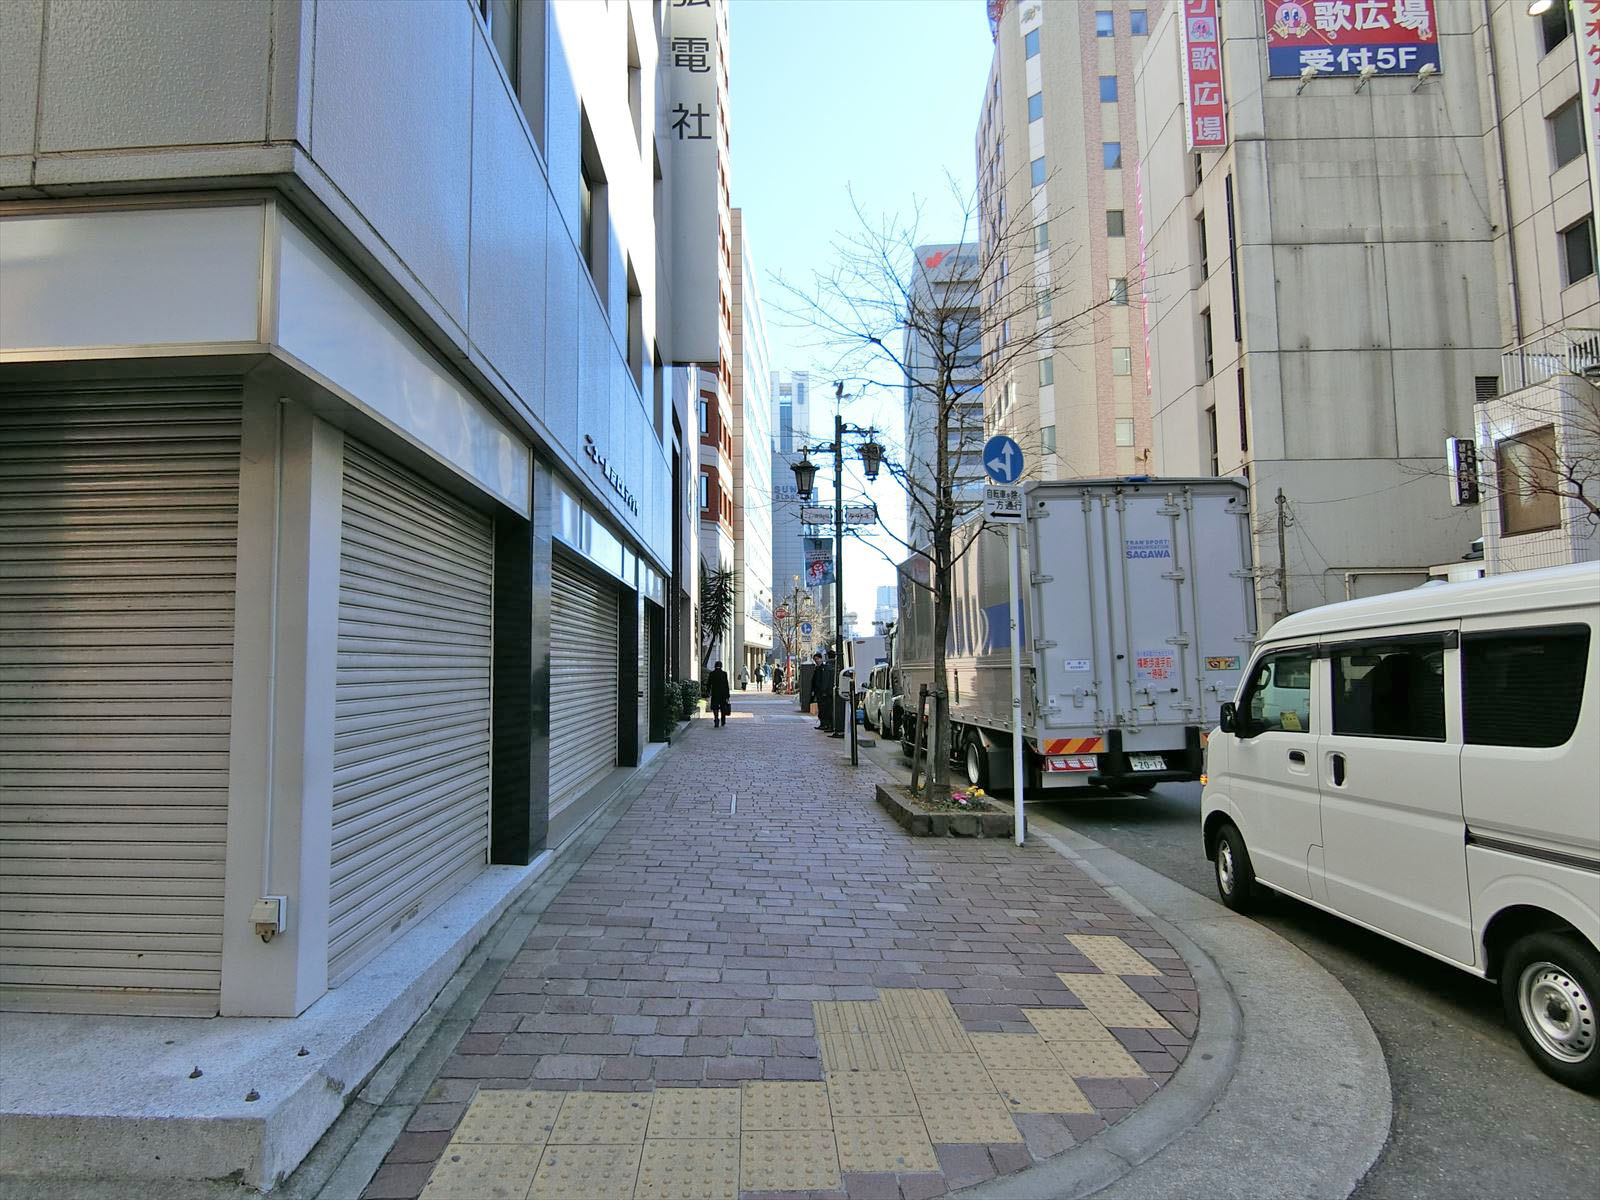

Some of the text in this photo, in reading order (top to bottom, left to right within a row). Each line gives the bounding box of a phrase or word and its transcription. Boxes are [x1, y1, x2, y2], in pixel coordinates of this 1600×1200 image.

[1314, 0, 1431, 32] 歌広場
[671, 0, 712, 140] 電社
[1299, 46, 1417, 73] 受付5F
[1190, 46, 1222, 142] 歌広場
[774, 485, 796, 493] SUN
[986, 500, 1022, 511] 一方通行
[1126, 550, 1171, 559] SAGAWA
